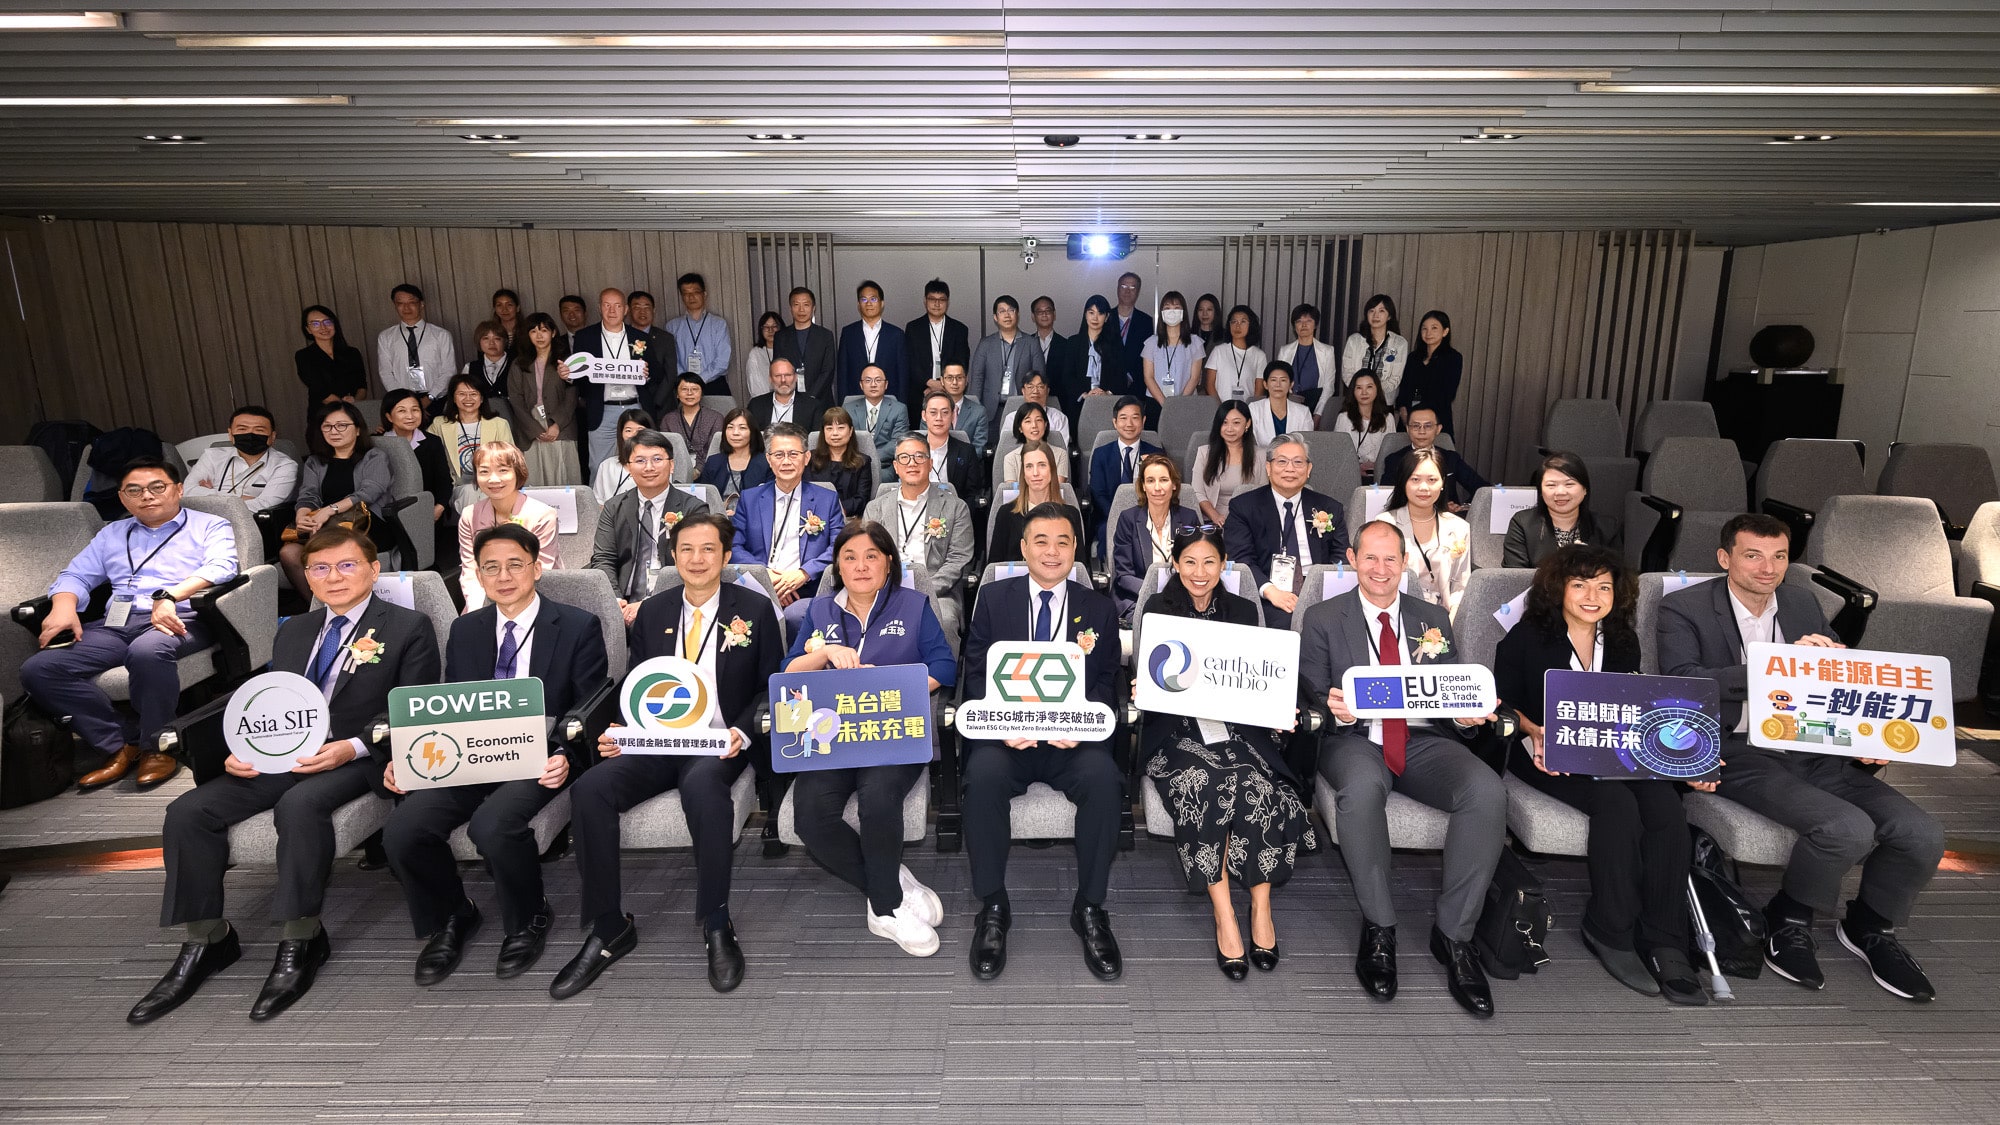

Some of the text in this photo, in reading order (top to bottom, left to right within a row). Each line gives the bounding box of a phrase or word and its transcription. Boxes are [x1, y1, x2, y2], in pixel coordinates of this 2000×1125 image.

[594, 363, 639, 372] semi
[1765, 656, 1934, 691] AI+能源自主
[1405, 676, 1438, 698] EU
[1441, 692, 1478, 701] & Trade
[408, 690, 512, 718] POWER
[835, 689, 902, 715] 為台灣
[1407, 701, 1440, 709] OFFICE
[1556, 700, 1642, 725] 金融賦能
[235, 708, 318, 736] Asia SIF
[966, 709, 1106, 725] 台灣ESG城市淨零突破協會
[466, 733, 535, 749] Economic
[837, 716, 926, 743] 未來充電
[1556, 725, 1642, 751] 永續未來
[468, 750, 520, 765] Growth
